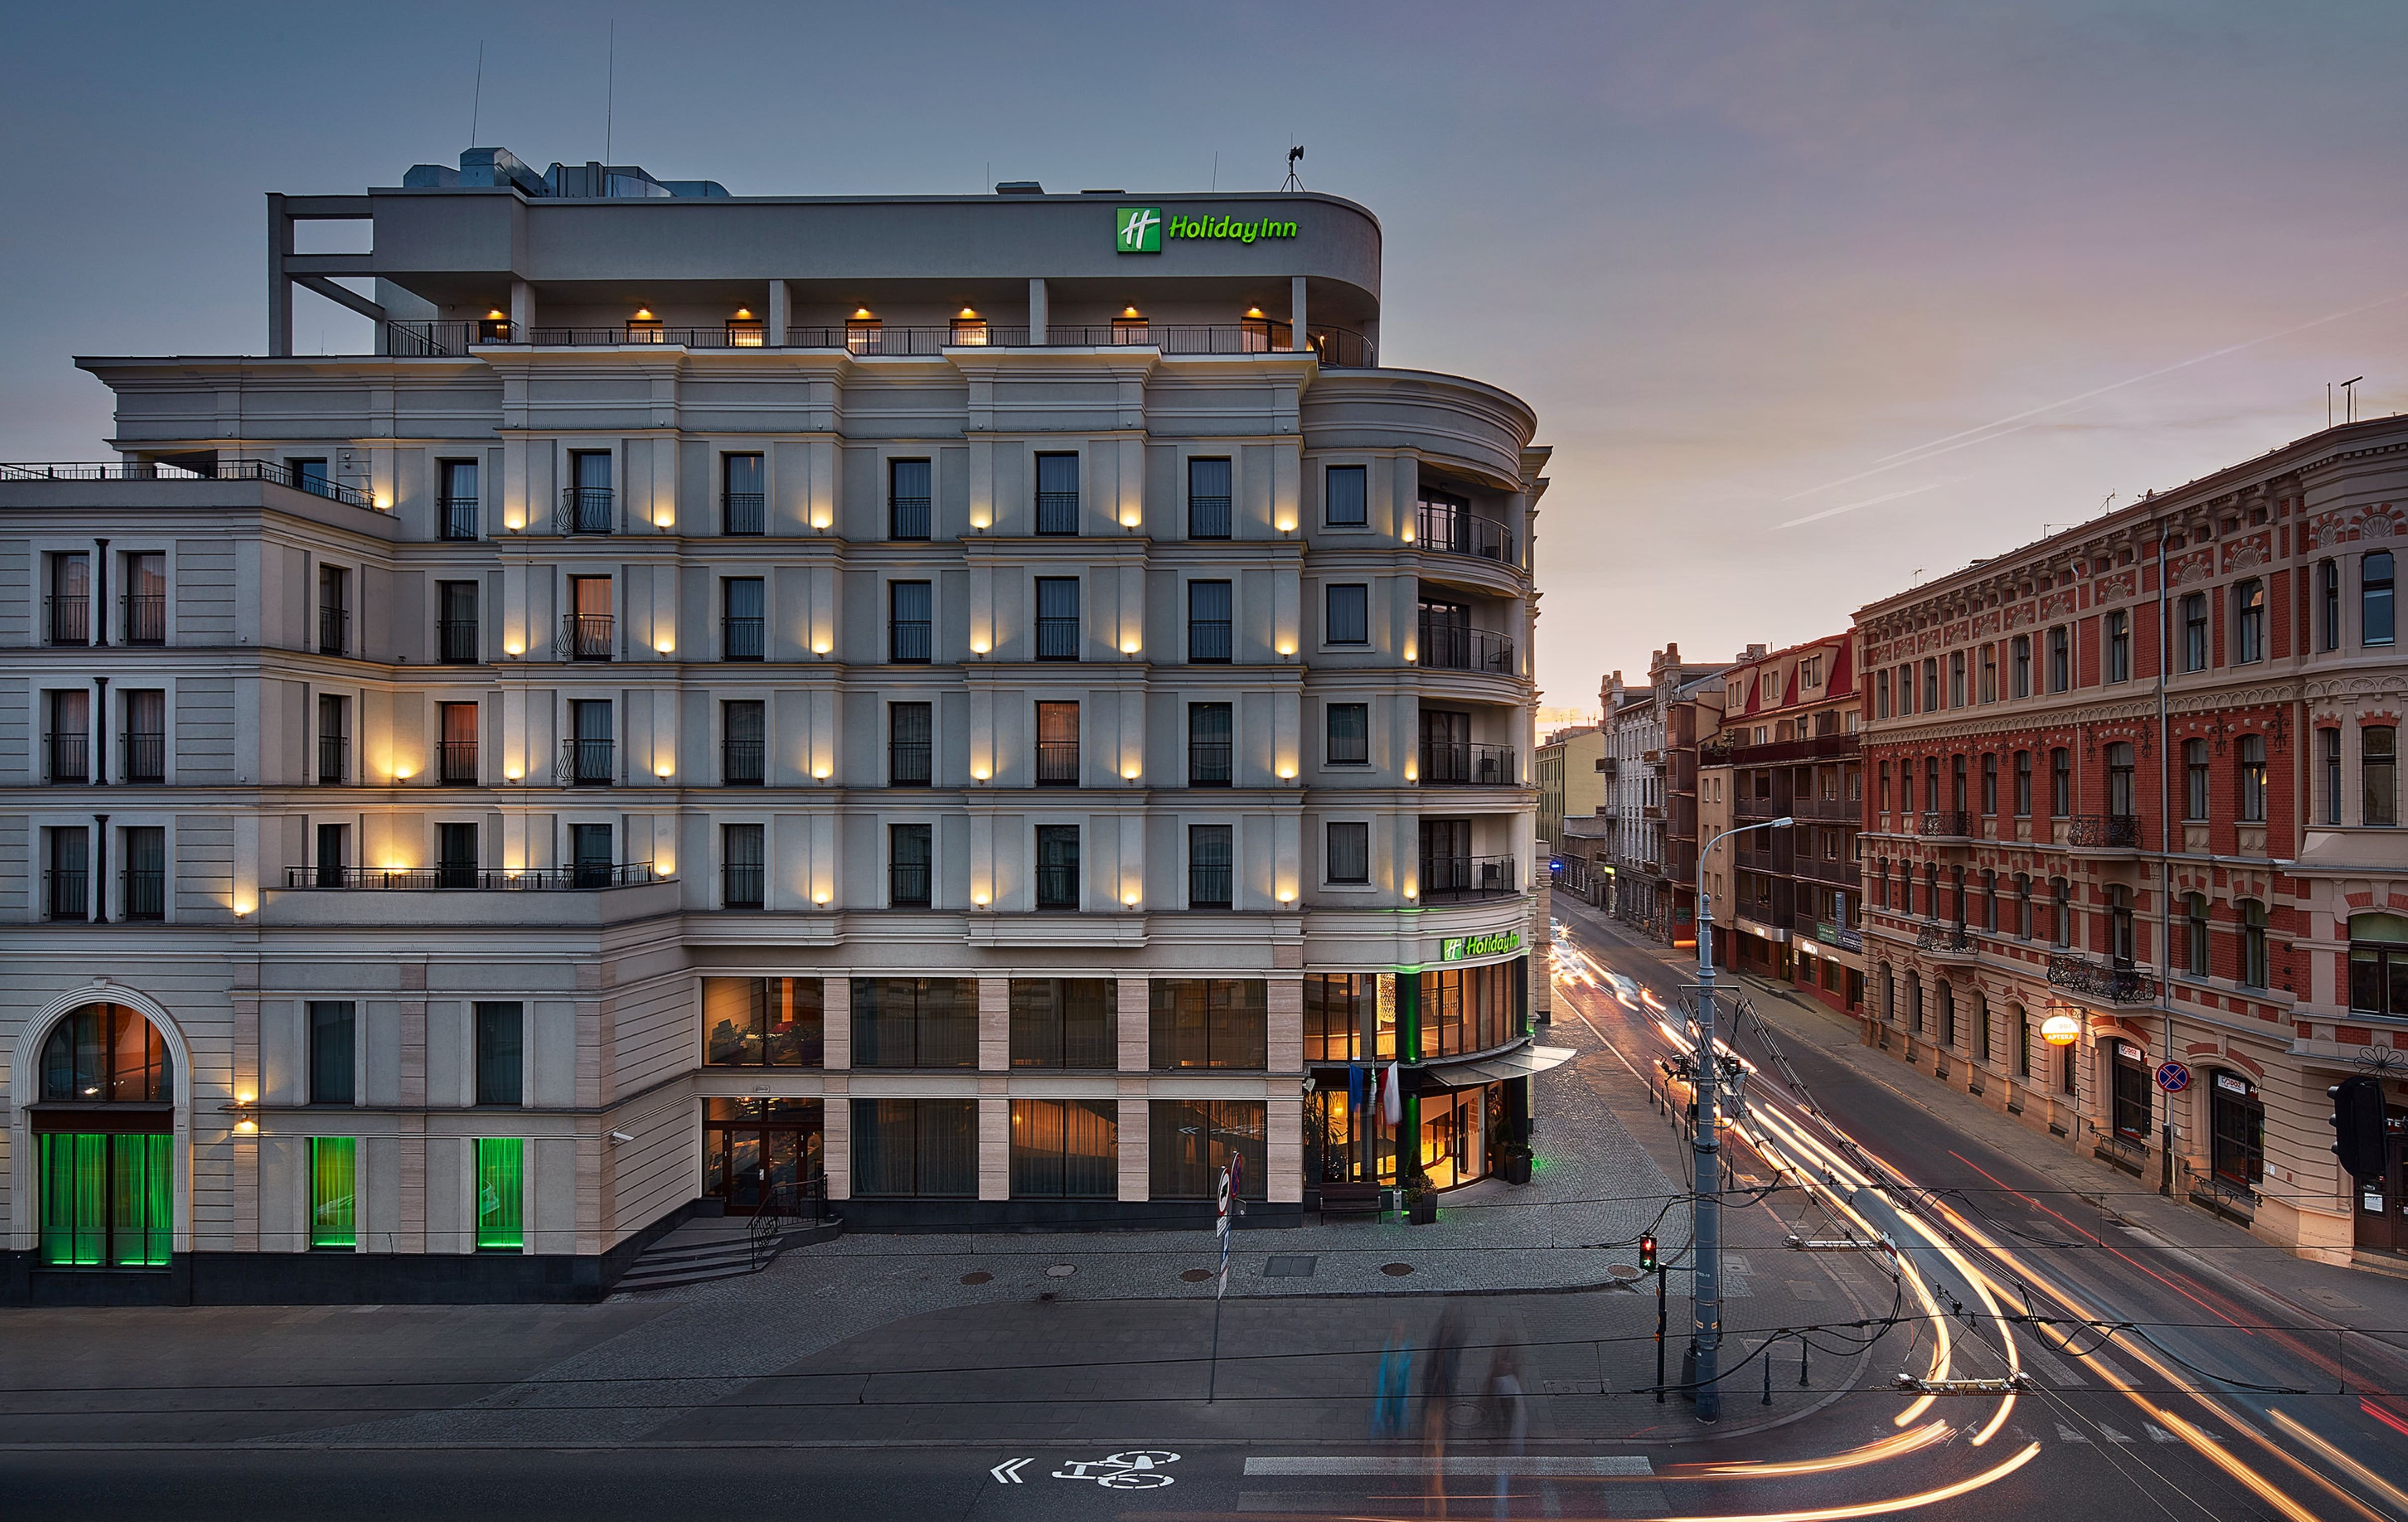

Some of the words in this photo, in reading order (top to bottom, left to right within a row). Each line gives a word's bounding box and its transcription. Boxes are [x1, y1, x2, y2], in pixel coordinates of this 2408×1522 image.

[1169, 214, 1258, 243] Holiday
[1261, 217, 1297, 238] Inn
[1466, 933, 1509, 955] Holiday
[1509, 930, 1519, 948] Inn
